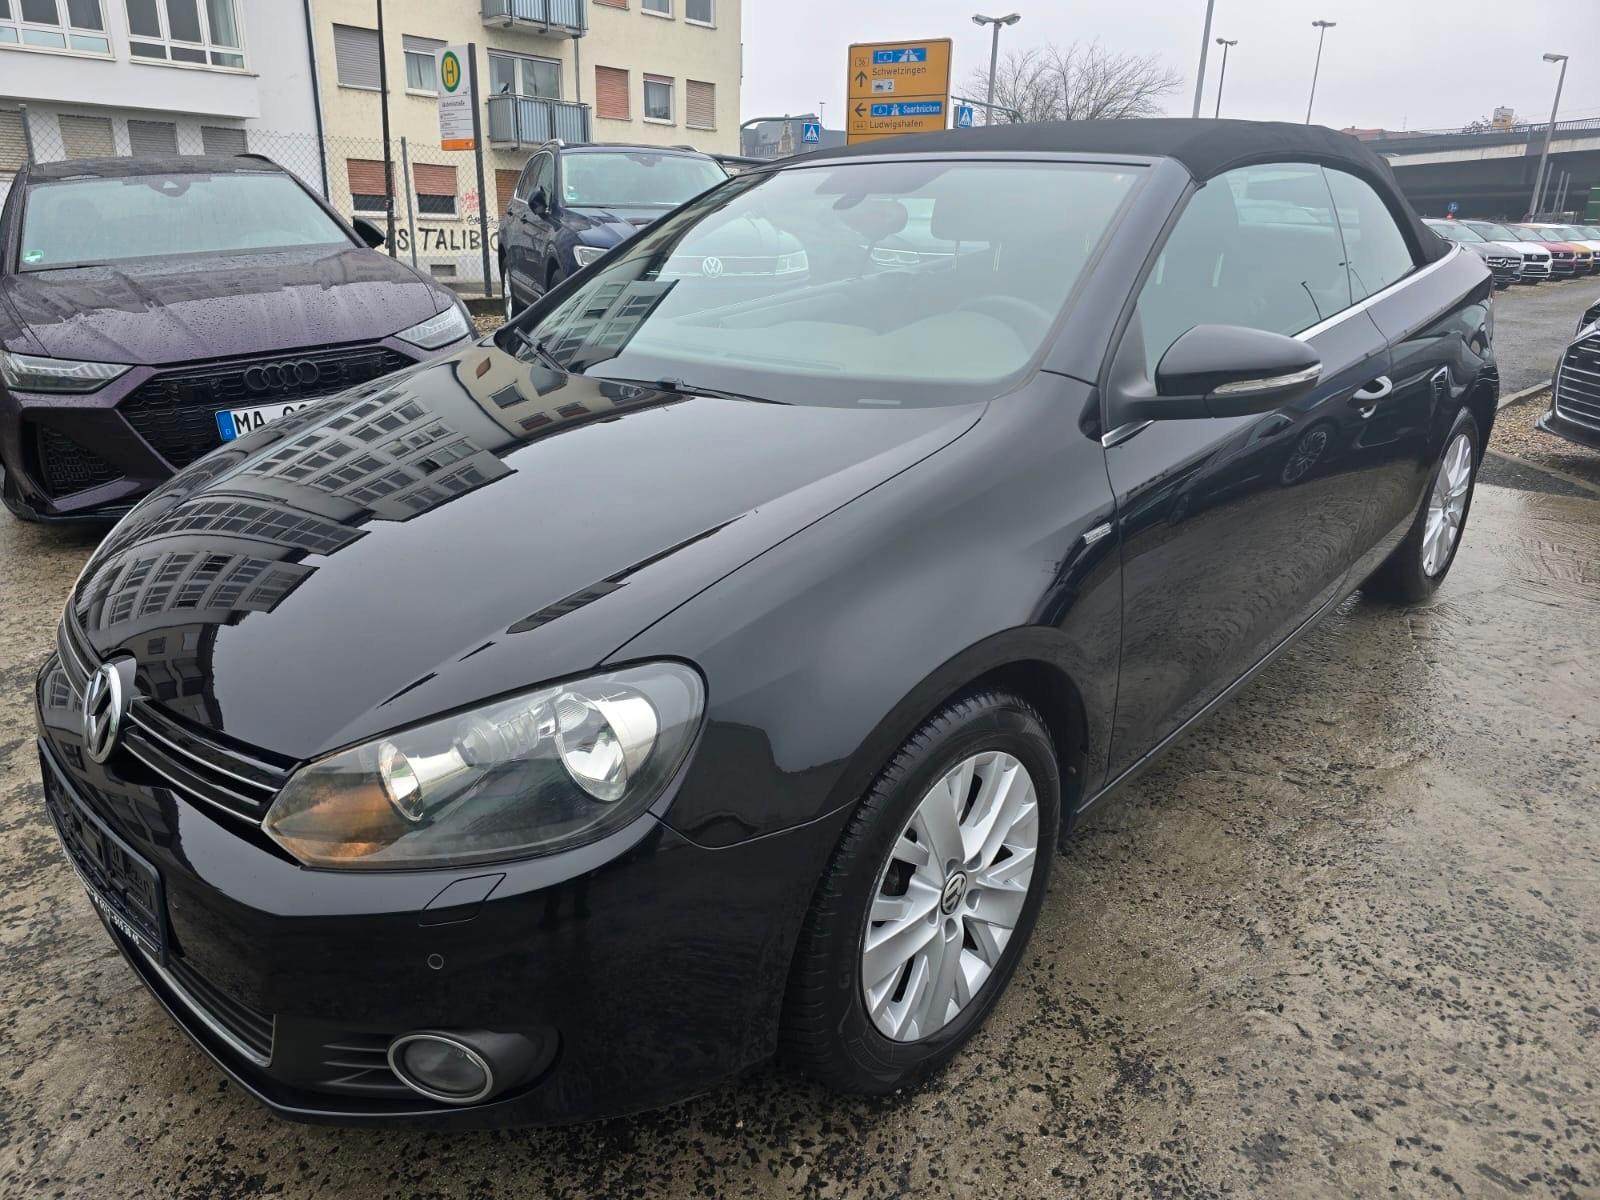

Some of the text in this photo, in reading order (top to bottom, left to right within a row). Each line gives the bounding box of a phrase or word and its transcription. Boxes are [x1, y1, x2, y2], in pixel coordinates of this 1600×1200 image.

[446, 59, 455, 84] H
[872, 66, 927, 76] Schwetzingen
[888, 81, 893, 90] 2
[903, 104, 940, 114] Saarbrücken
[869, 119, 924, 129] Ludwigshafen
